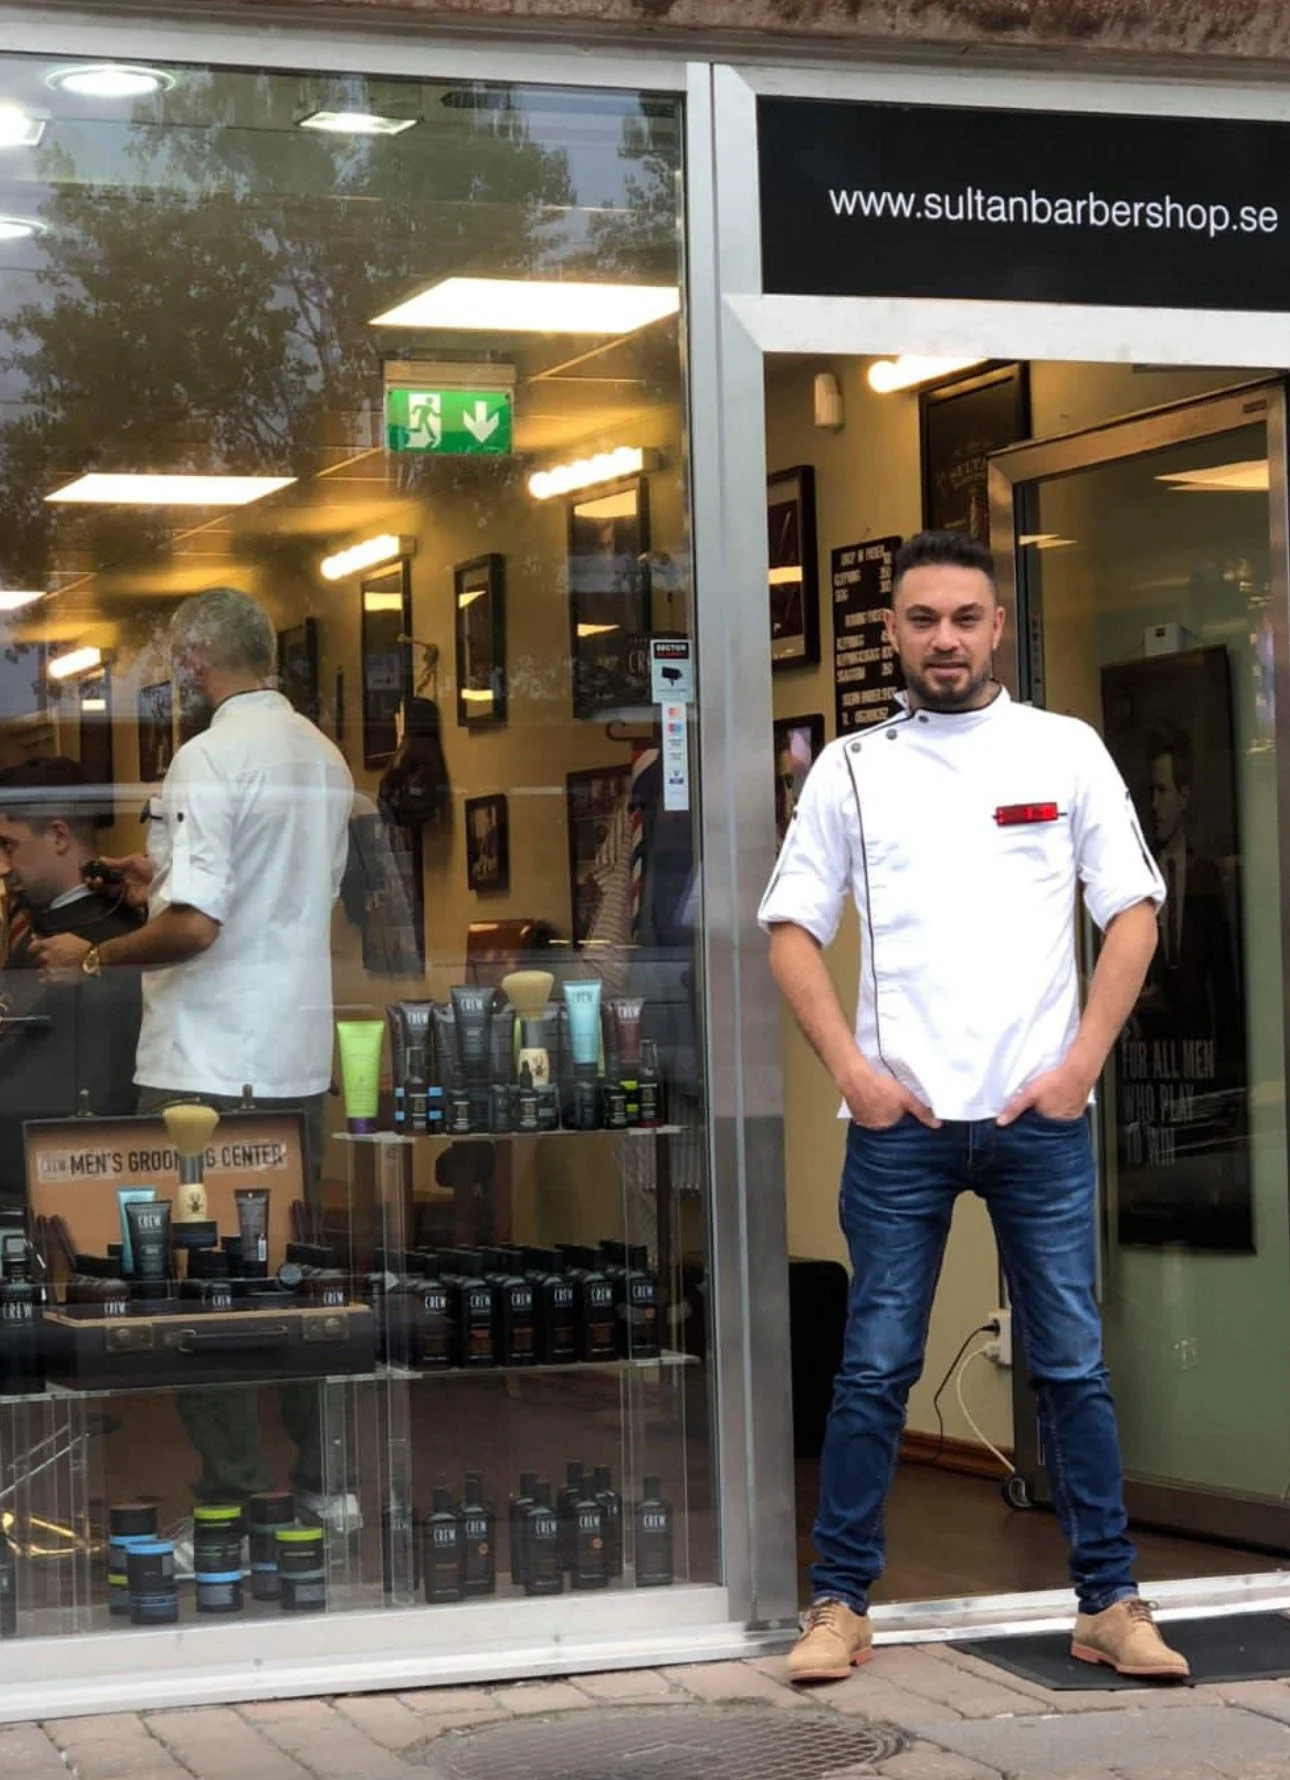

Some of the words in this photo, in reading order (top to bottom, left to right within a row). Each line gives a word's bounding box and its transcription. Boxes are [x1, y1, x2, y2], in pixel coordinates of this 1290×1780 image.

[828, 186, 1279, 237] www.sultanbarbershop.se
[1153, 1040, 1180, 1079] ALL
[1182, 1040, 1215, 1079] MEN
[70, 1152, 123, 1175] MEN'S
[128, 1147, 216, 1172] GROOG
[222, 1144, 283, 1167] CENTER
[138, 1215, 162, 1230] CREW
[322, 1291, 344, 1304] CREW
[424, 1296, 446, 1309] CREW
[511, 1293, 532, 1307] CREW
[2, 1302, 32, 1320] CREW
[466, 1520, 487, 1533] CREW
[536, 1520, 557, 1533] CREW
[579, 1515, 600, 1529] CREW
[643, 1515, 666, 1529] CREW
[433, 1527, 456, 1542] CREW
